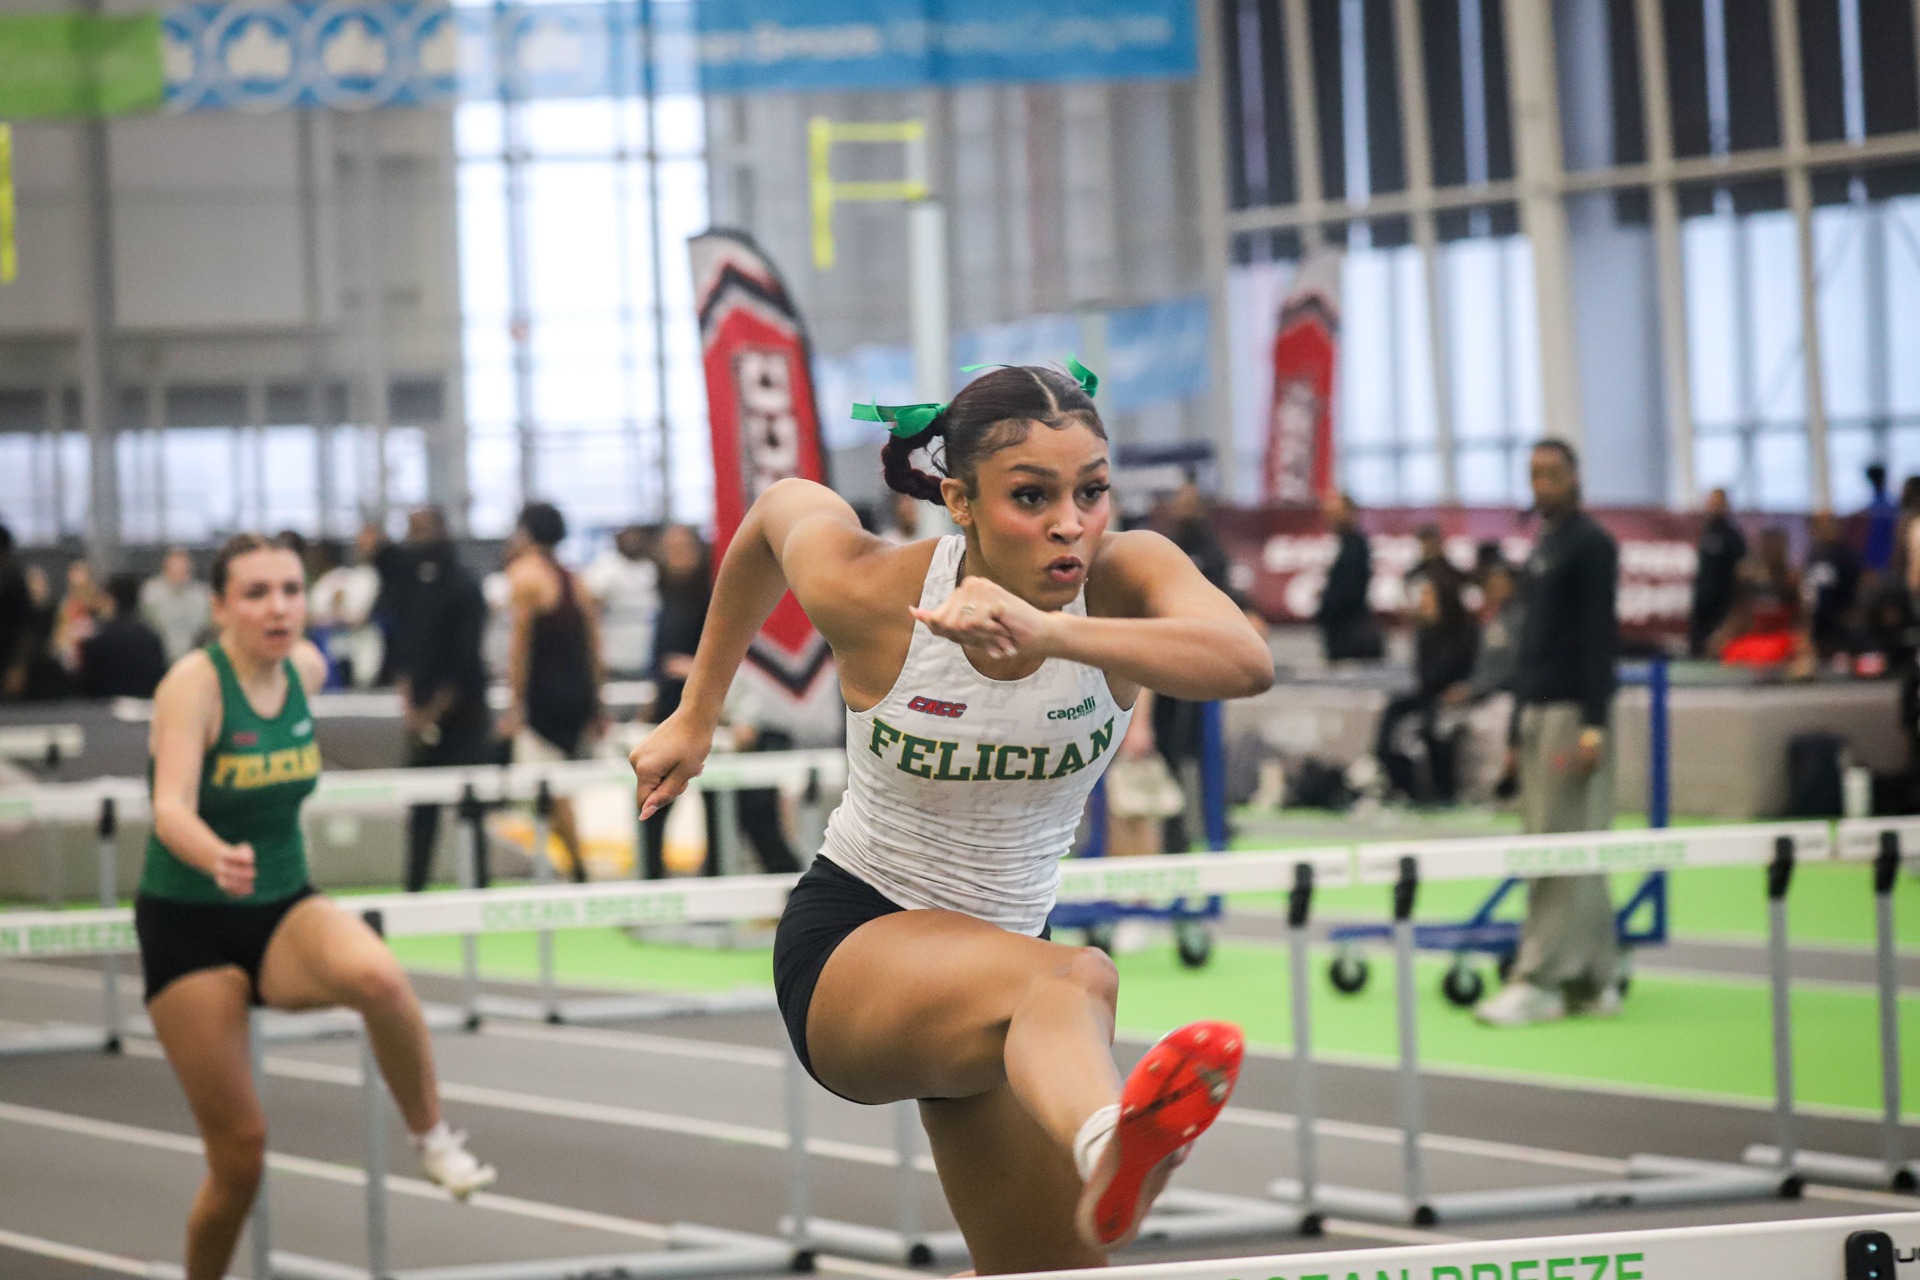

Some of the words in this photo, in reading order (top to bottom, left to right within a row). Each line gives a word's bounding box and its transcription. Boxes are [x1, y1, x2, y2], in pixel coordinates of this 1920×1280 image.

[908, 696, 967, 718] CACC
[1047, 696, 1096, 720] capelli
[869, 717, 1115, 782] FELICIAN
